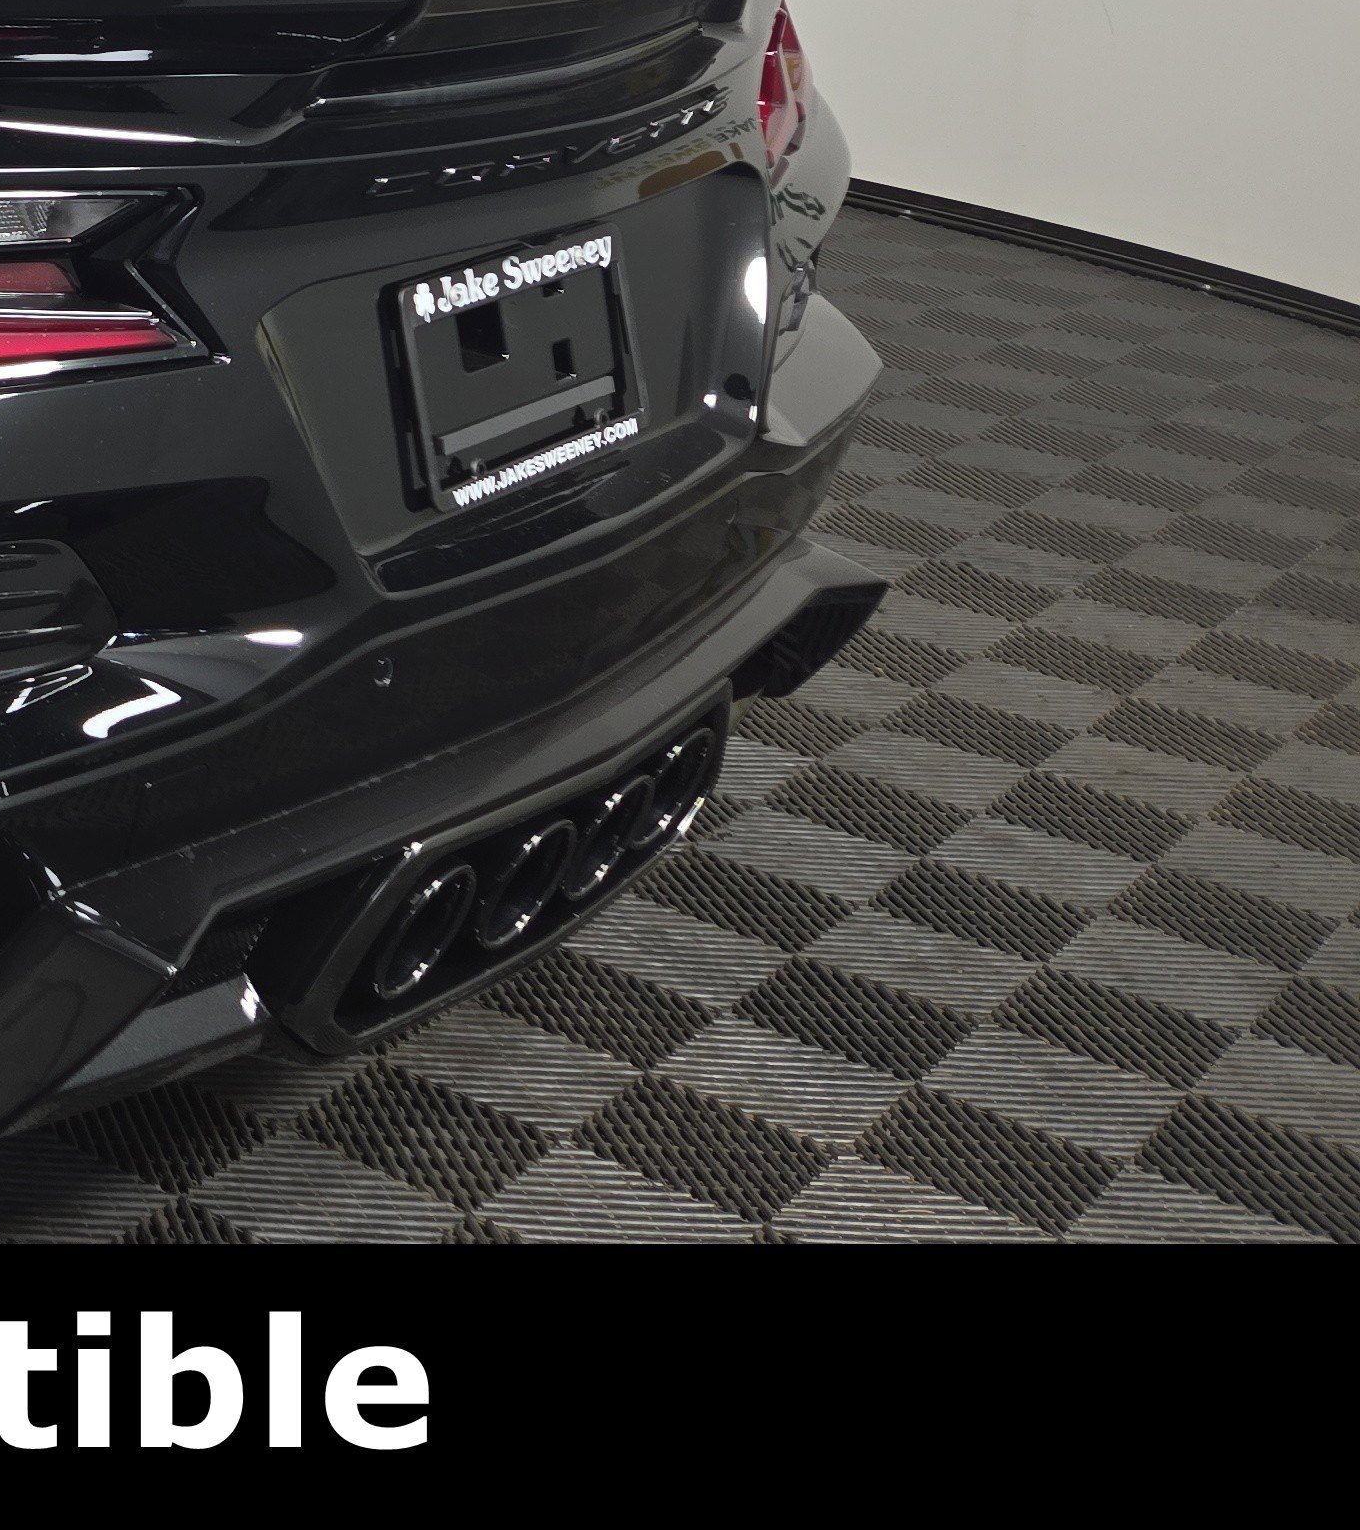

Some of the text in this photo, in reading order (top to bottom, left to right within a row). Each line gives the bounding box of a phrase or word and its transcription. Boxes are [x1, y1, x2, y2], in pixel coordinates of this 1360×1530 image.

[437, 236, 612, 313] Jake Sweeney
[453, 418, 639, 507] WWW.JAKESWEENEY.COM
